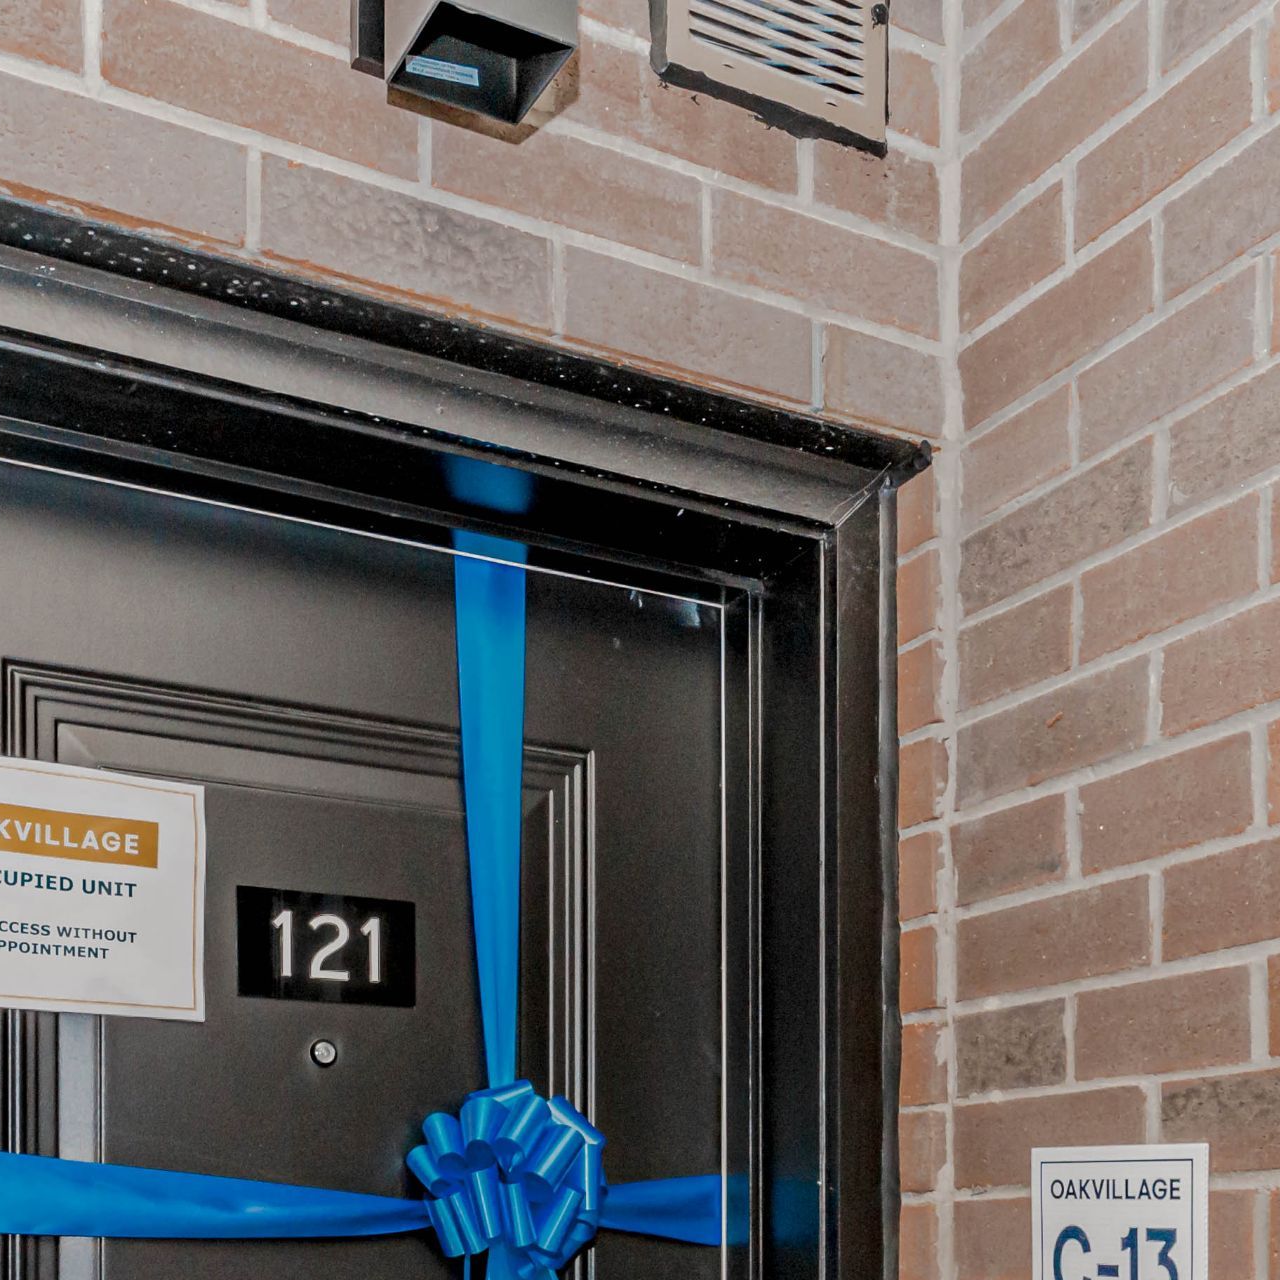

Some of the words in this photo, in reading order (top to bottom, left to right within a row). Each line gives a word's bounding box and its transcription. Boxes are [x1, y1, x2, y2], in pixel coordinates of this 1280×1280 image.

[82, 878, 137, 898] UNIT
[57, 926, 137, 944] WITHOUT
[272, 909, 381, 984] 121
[1050, 1178, 1181, 1200] OAKVILLAGE
